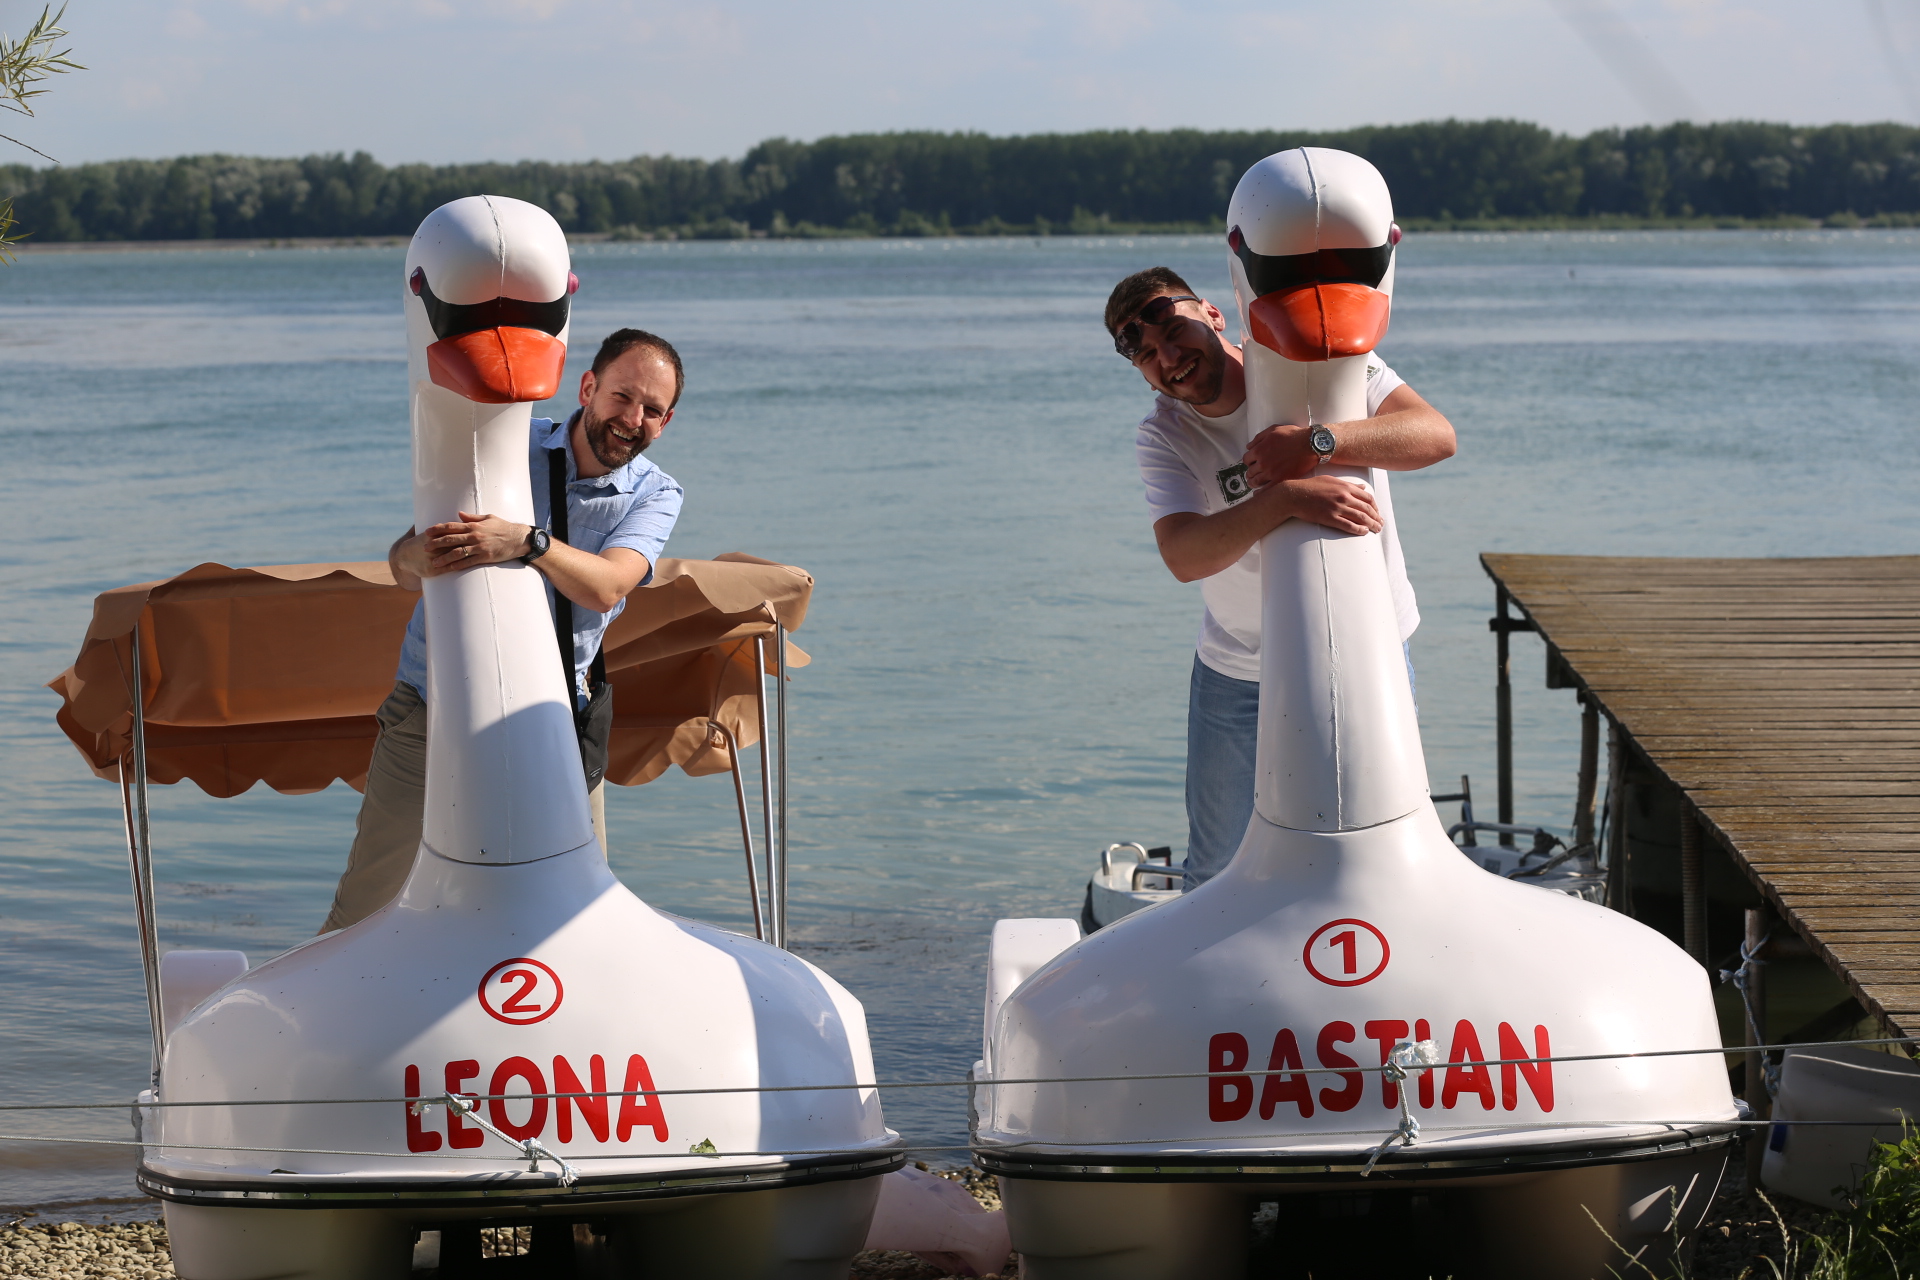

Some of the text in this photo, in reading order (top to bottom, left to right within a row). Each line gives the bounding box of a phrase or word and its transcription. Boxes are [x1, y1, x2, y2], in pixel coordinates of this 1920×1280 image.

[1329, 930, 1357, 974] 1
[500, 969, 541, 1014] 2
[404, 1053, 669, 1153] LEONA
[1208, 1018, 1555, 1123] BASTIAN
